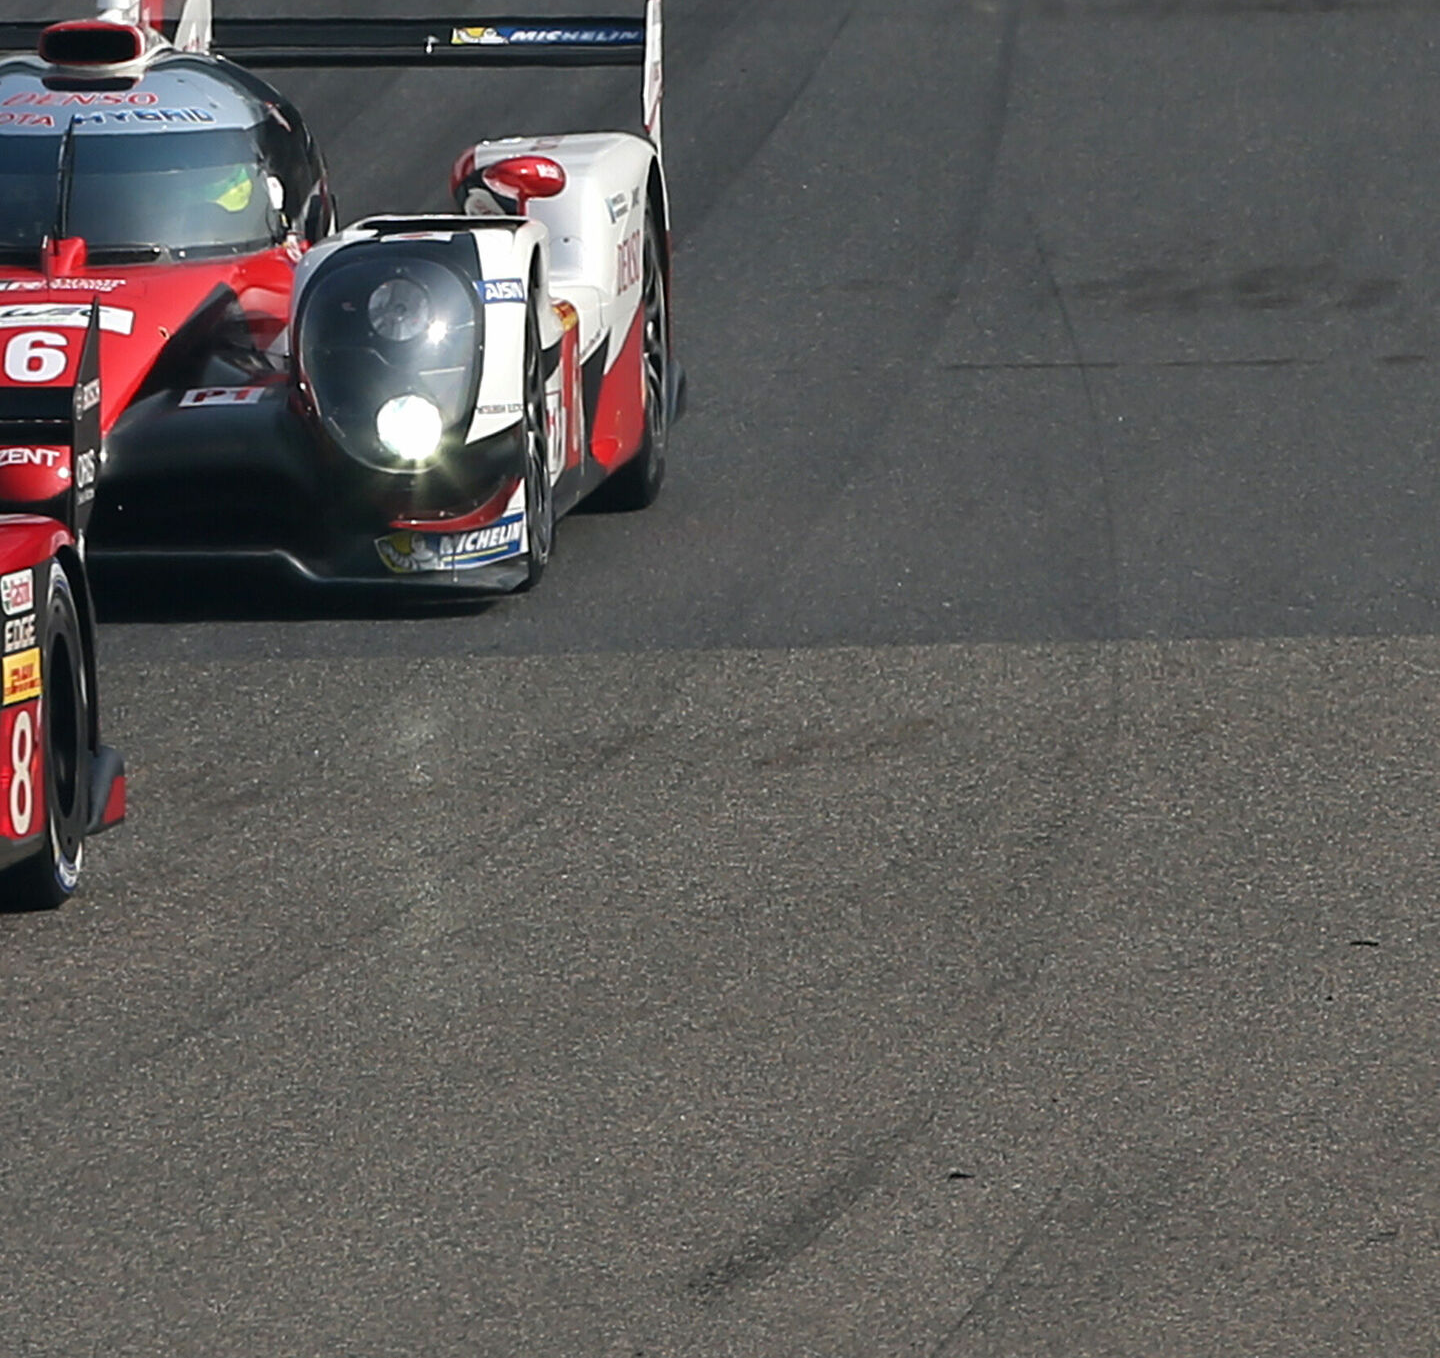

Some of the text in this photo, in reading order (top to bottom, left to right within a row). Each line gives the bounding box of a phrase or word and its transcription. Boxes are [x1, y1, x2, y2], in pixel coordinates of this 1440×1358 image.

[510, 30, 640, 42] MICHELIN
[0, 92, 160, 107] DENSO
[4, 330, 68, 382] 6
[192, 388, 253, 403] P1
[440, 521, 522, 555] MICHELIN
[10, 711, 32, 835] 8
